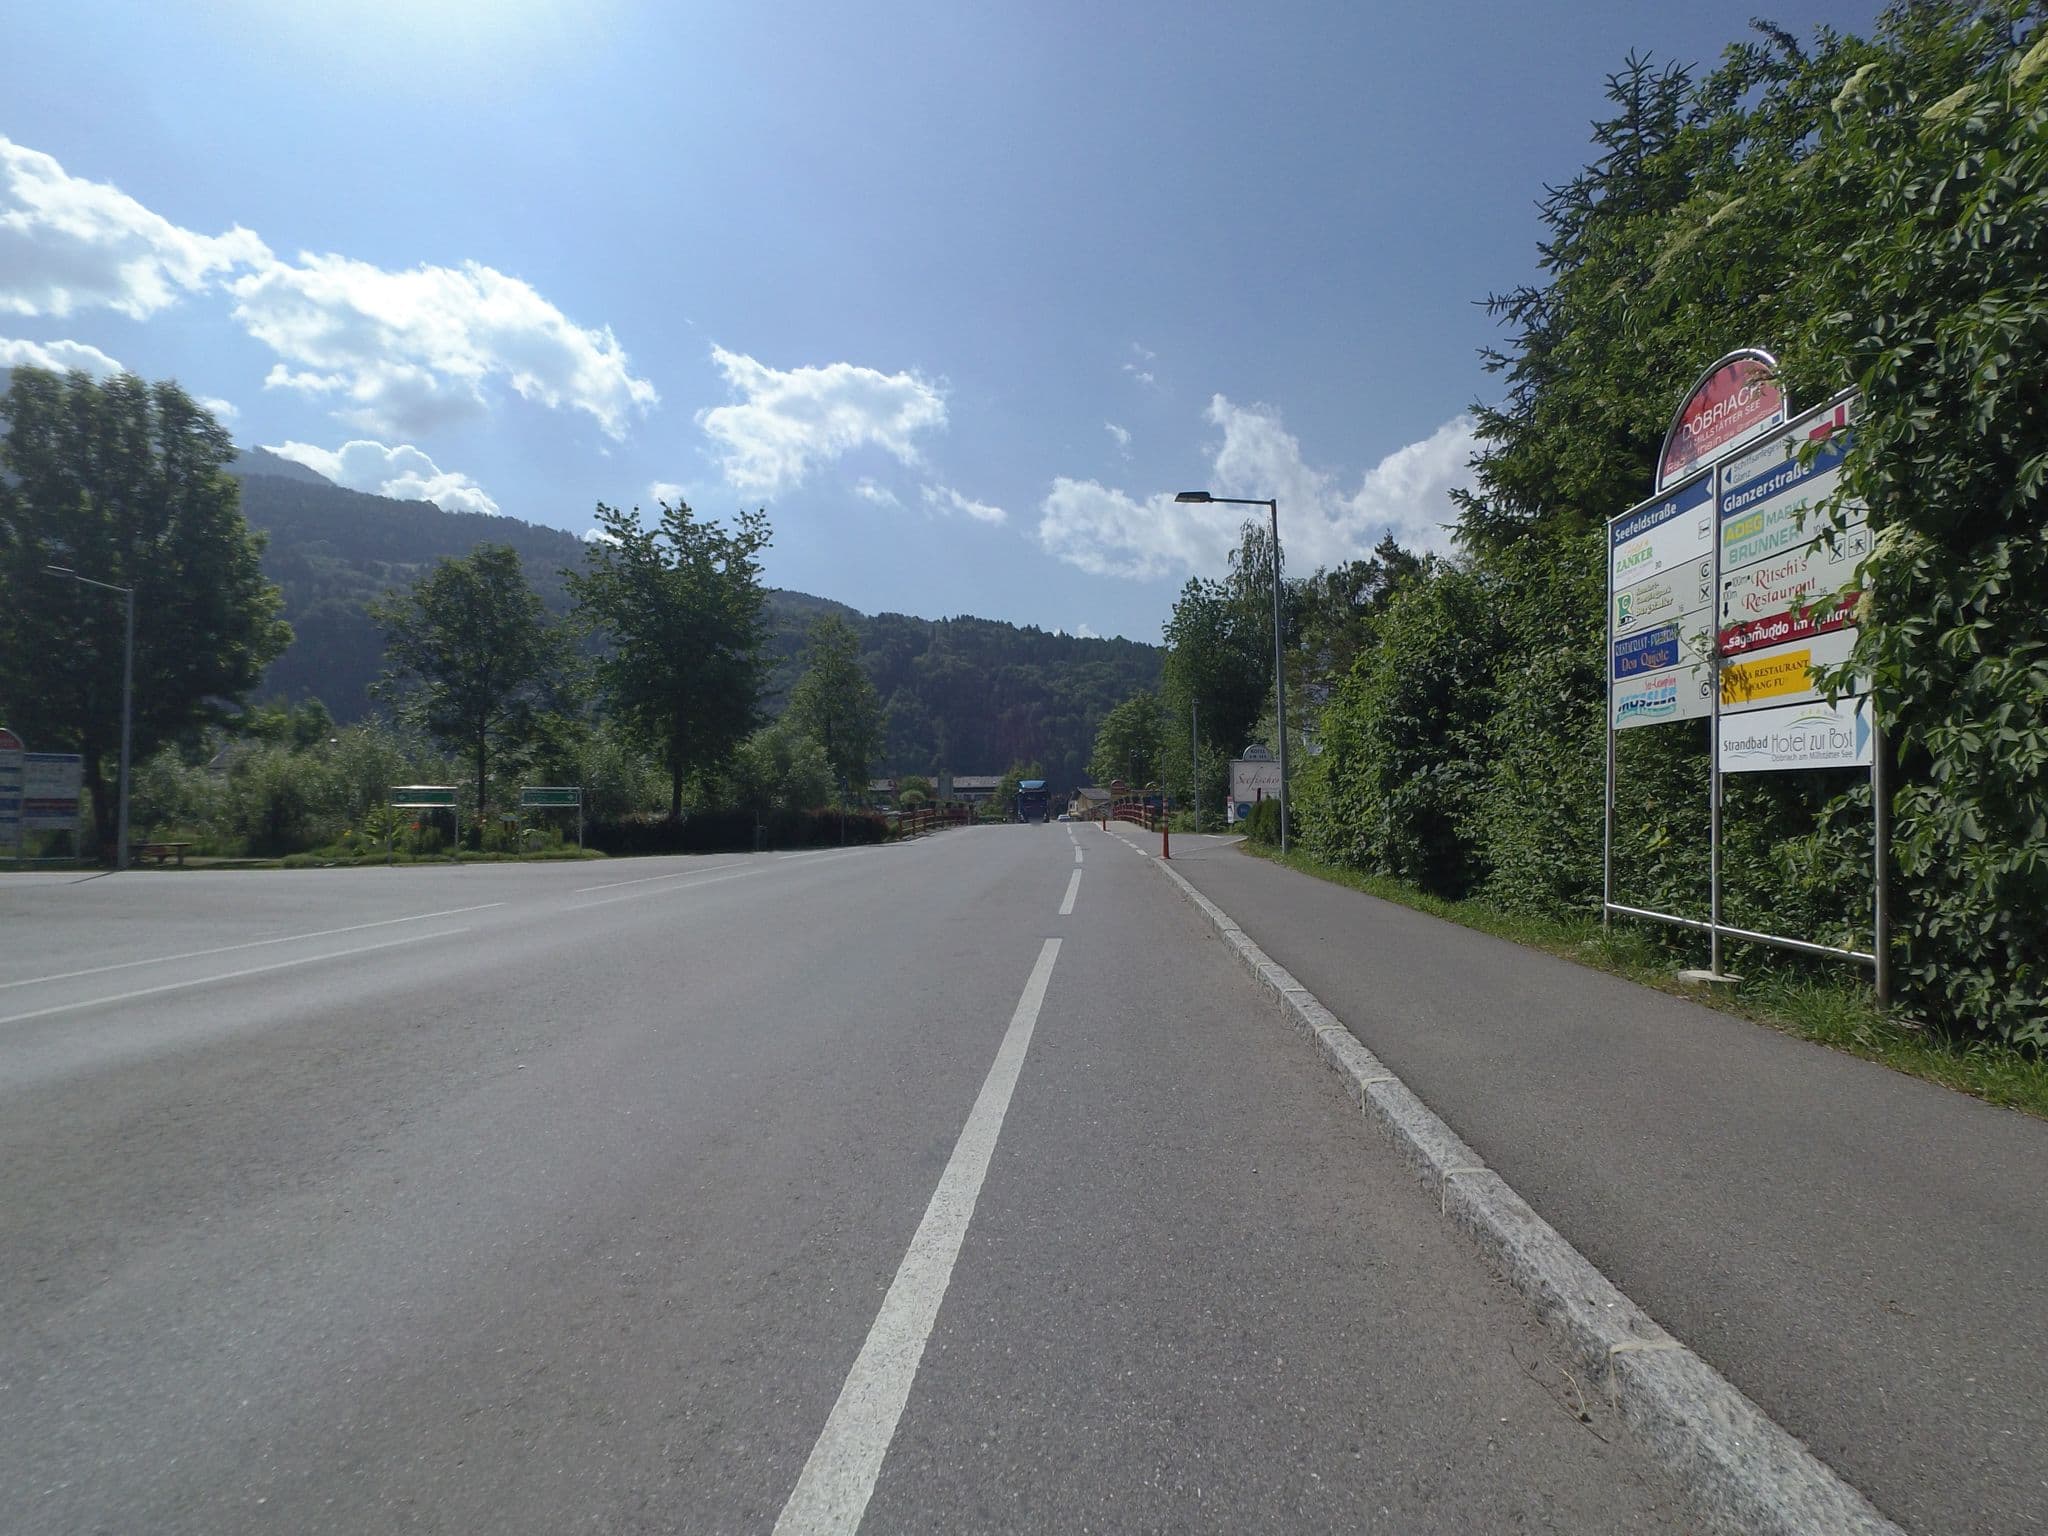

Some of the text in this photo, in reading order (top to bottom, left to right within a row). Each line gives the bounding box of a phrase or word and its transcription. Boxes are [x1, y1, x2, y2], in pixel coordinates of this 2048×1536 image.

[1745, 400, 1761, 417] SEE
[1723, 461, 1811, 513] Glanzerstraße
[1615, 502, 1678, 543] Seefeldstraße
[1724, 513, 1763, 545] ADEG
[1616, 545, 1653, 574] ZANKER
[1729, 524, 1800, 564] BRUNNER
[1751, 557, 1808, 591] Ritschi's
[1741, 577, 1816, 613] Restaurant
[1755, 659, 1809, 678] RESTAURANT
[1723, 728, 1854, 753] Strandbad Hotel zur Post
